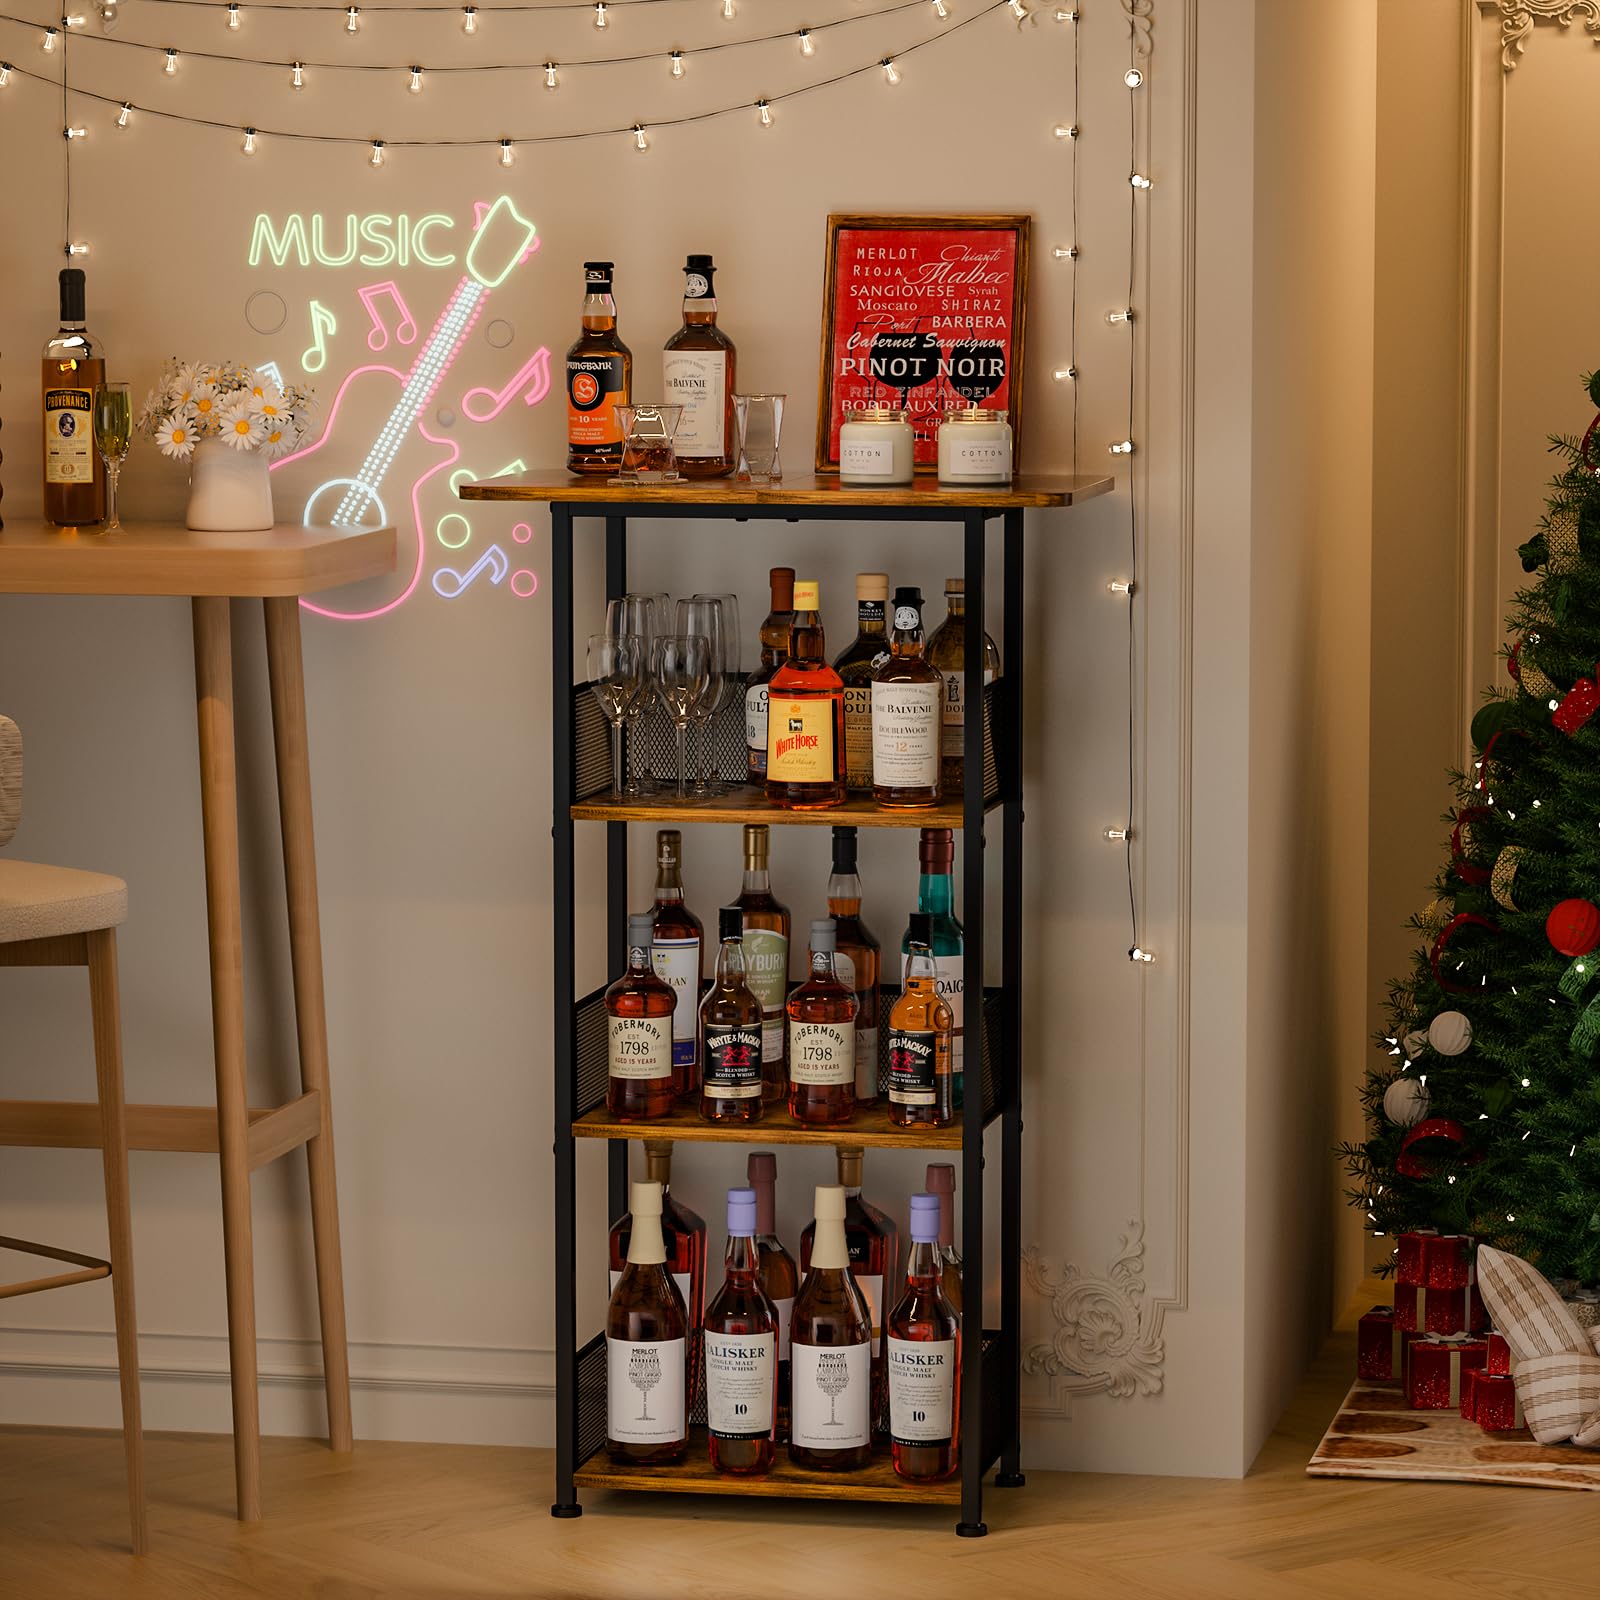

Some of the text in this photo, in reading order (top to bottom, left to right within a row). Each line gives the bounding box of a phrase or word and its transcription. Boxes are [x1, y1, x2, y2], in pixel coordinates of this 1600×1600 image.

[249, 214, 456, 267] MUSIC
[856, 247, 918, 260] MERLOT
[940, 244, 1005, 262] Chianti
[853, 265, 902, 277] RIOJA
[903, 261, 1010, 285] Malbec
[850, 284, 955, 297] SANGIOVESE
[968, 286, 998, 297] Syrah
[857, 298, 918, 311] Moscato
[941, 299, 1001, 311] SHIRAZ
[863, 312, 922, 329] Port
[932, 315, 1007, 328] BARBERA
[846, 331, 1007, 353] Cabernet Sauvignon
[839, 358, 1006, 377] PINOT NOIR
[673, 378, 706, 388] BALVENIE
[850, 386, 887, 398] RED
[47, 394, 88, 409] PROVENANCE
[841, 399, 938, 412] BORDEAUX
[579, 415, 590, 424] 10
[887, 704, 934, 713] BALVENIE
[776, 734, 818, 760] WHITE HORSE
[895, 742, 907, 753] 12
[611, 1020, 661, 1040] TOBERMORY
[794, 1025, 844, 1046] TOBERMORY
[620, 1041, 649, 1055] 1798
[901, 1037, 932, 1057] MACKAY
[803, 1047, 833, 1061] 1798
[888, 1352, 944, 1365] ALISKER
[735, 1404, 747, 1415] 10
[912, 1411, 926, 1422] 10
